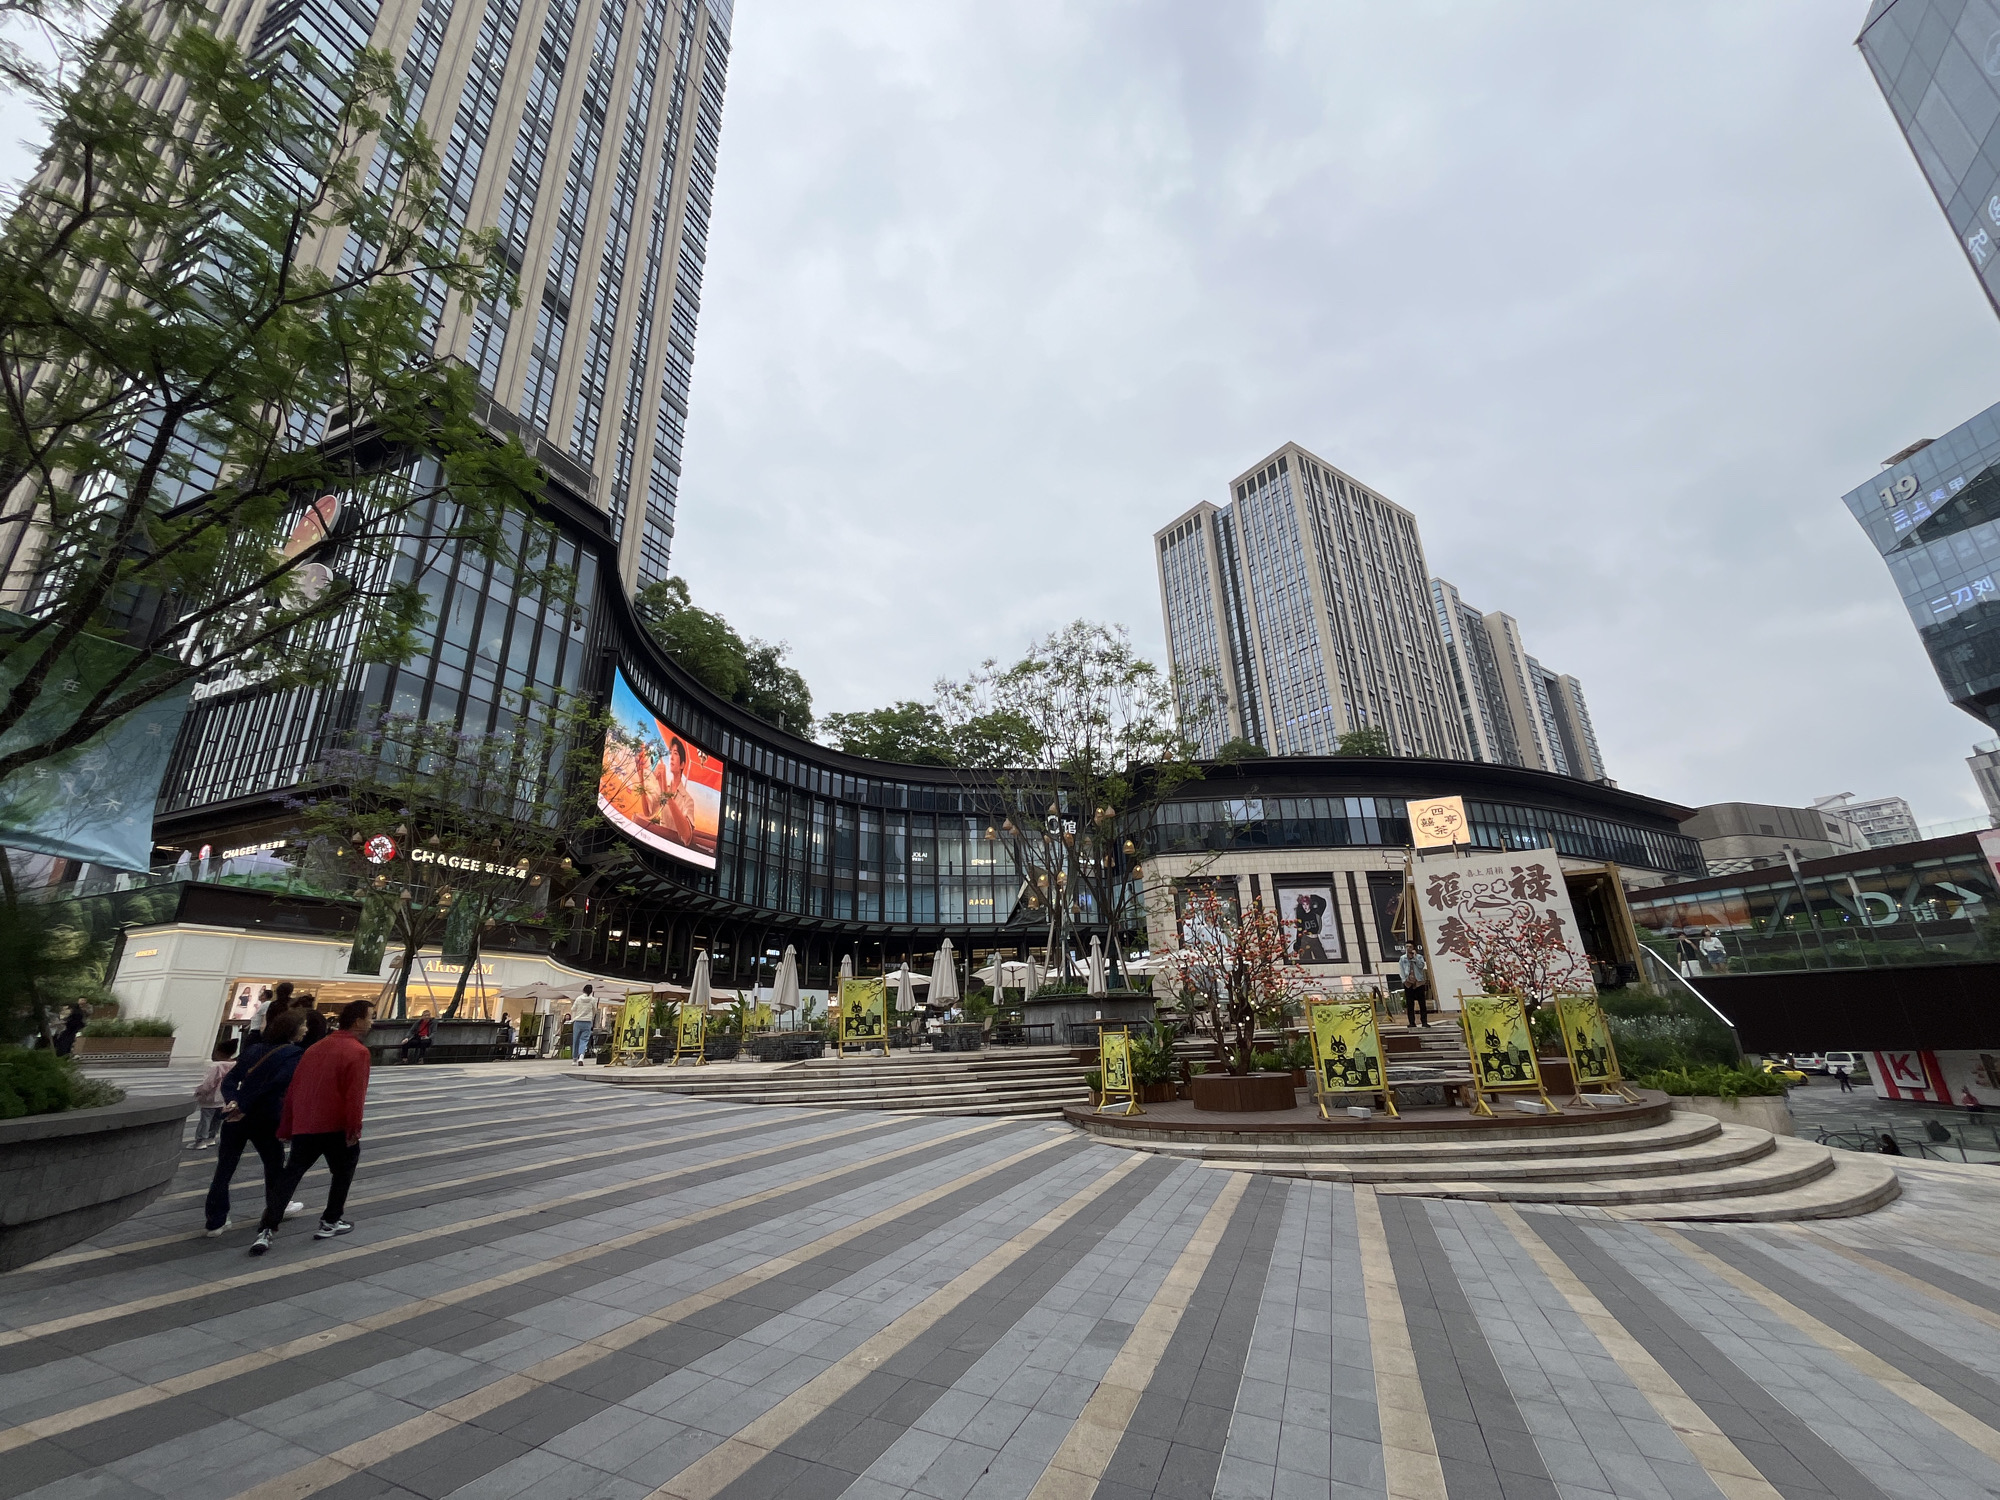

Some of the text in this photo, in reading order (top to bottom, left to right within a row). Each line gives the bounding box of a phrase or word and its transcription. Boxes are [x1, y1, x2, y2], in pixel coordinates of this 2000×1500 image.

[1880, 475, 1918, 509] 19
[1931, 575, 1996, 614] 二刀刘
[1431, 807, 1444, 816] 四
[1434, 825, 1449, 836] 茶
[222, 844, 258, 860] CHAGEE
[411, 849, 482, 872] CHAGEE
[1426, 871, 1463, 911] 福
[1508, 863, 1558, 902] 禄
[1435, 915, 1474, 959] 寿
[1888, 1053, 1921, 1082] K
